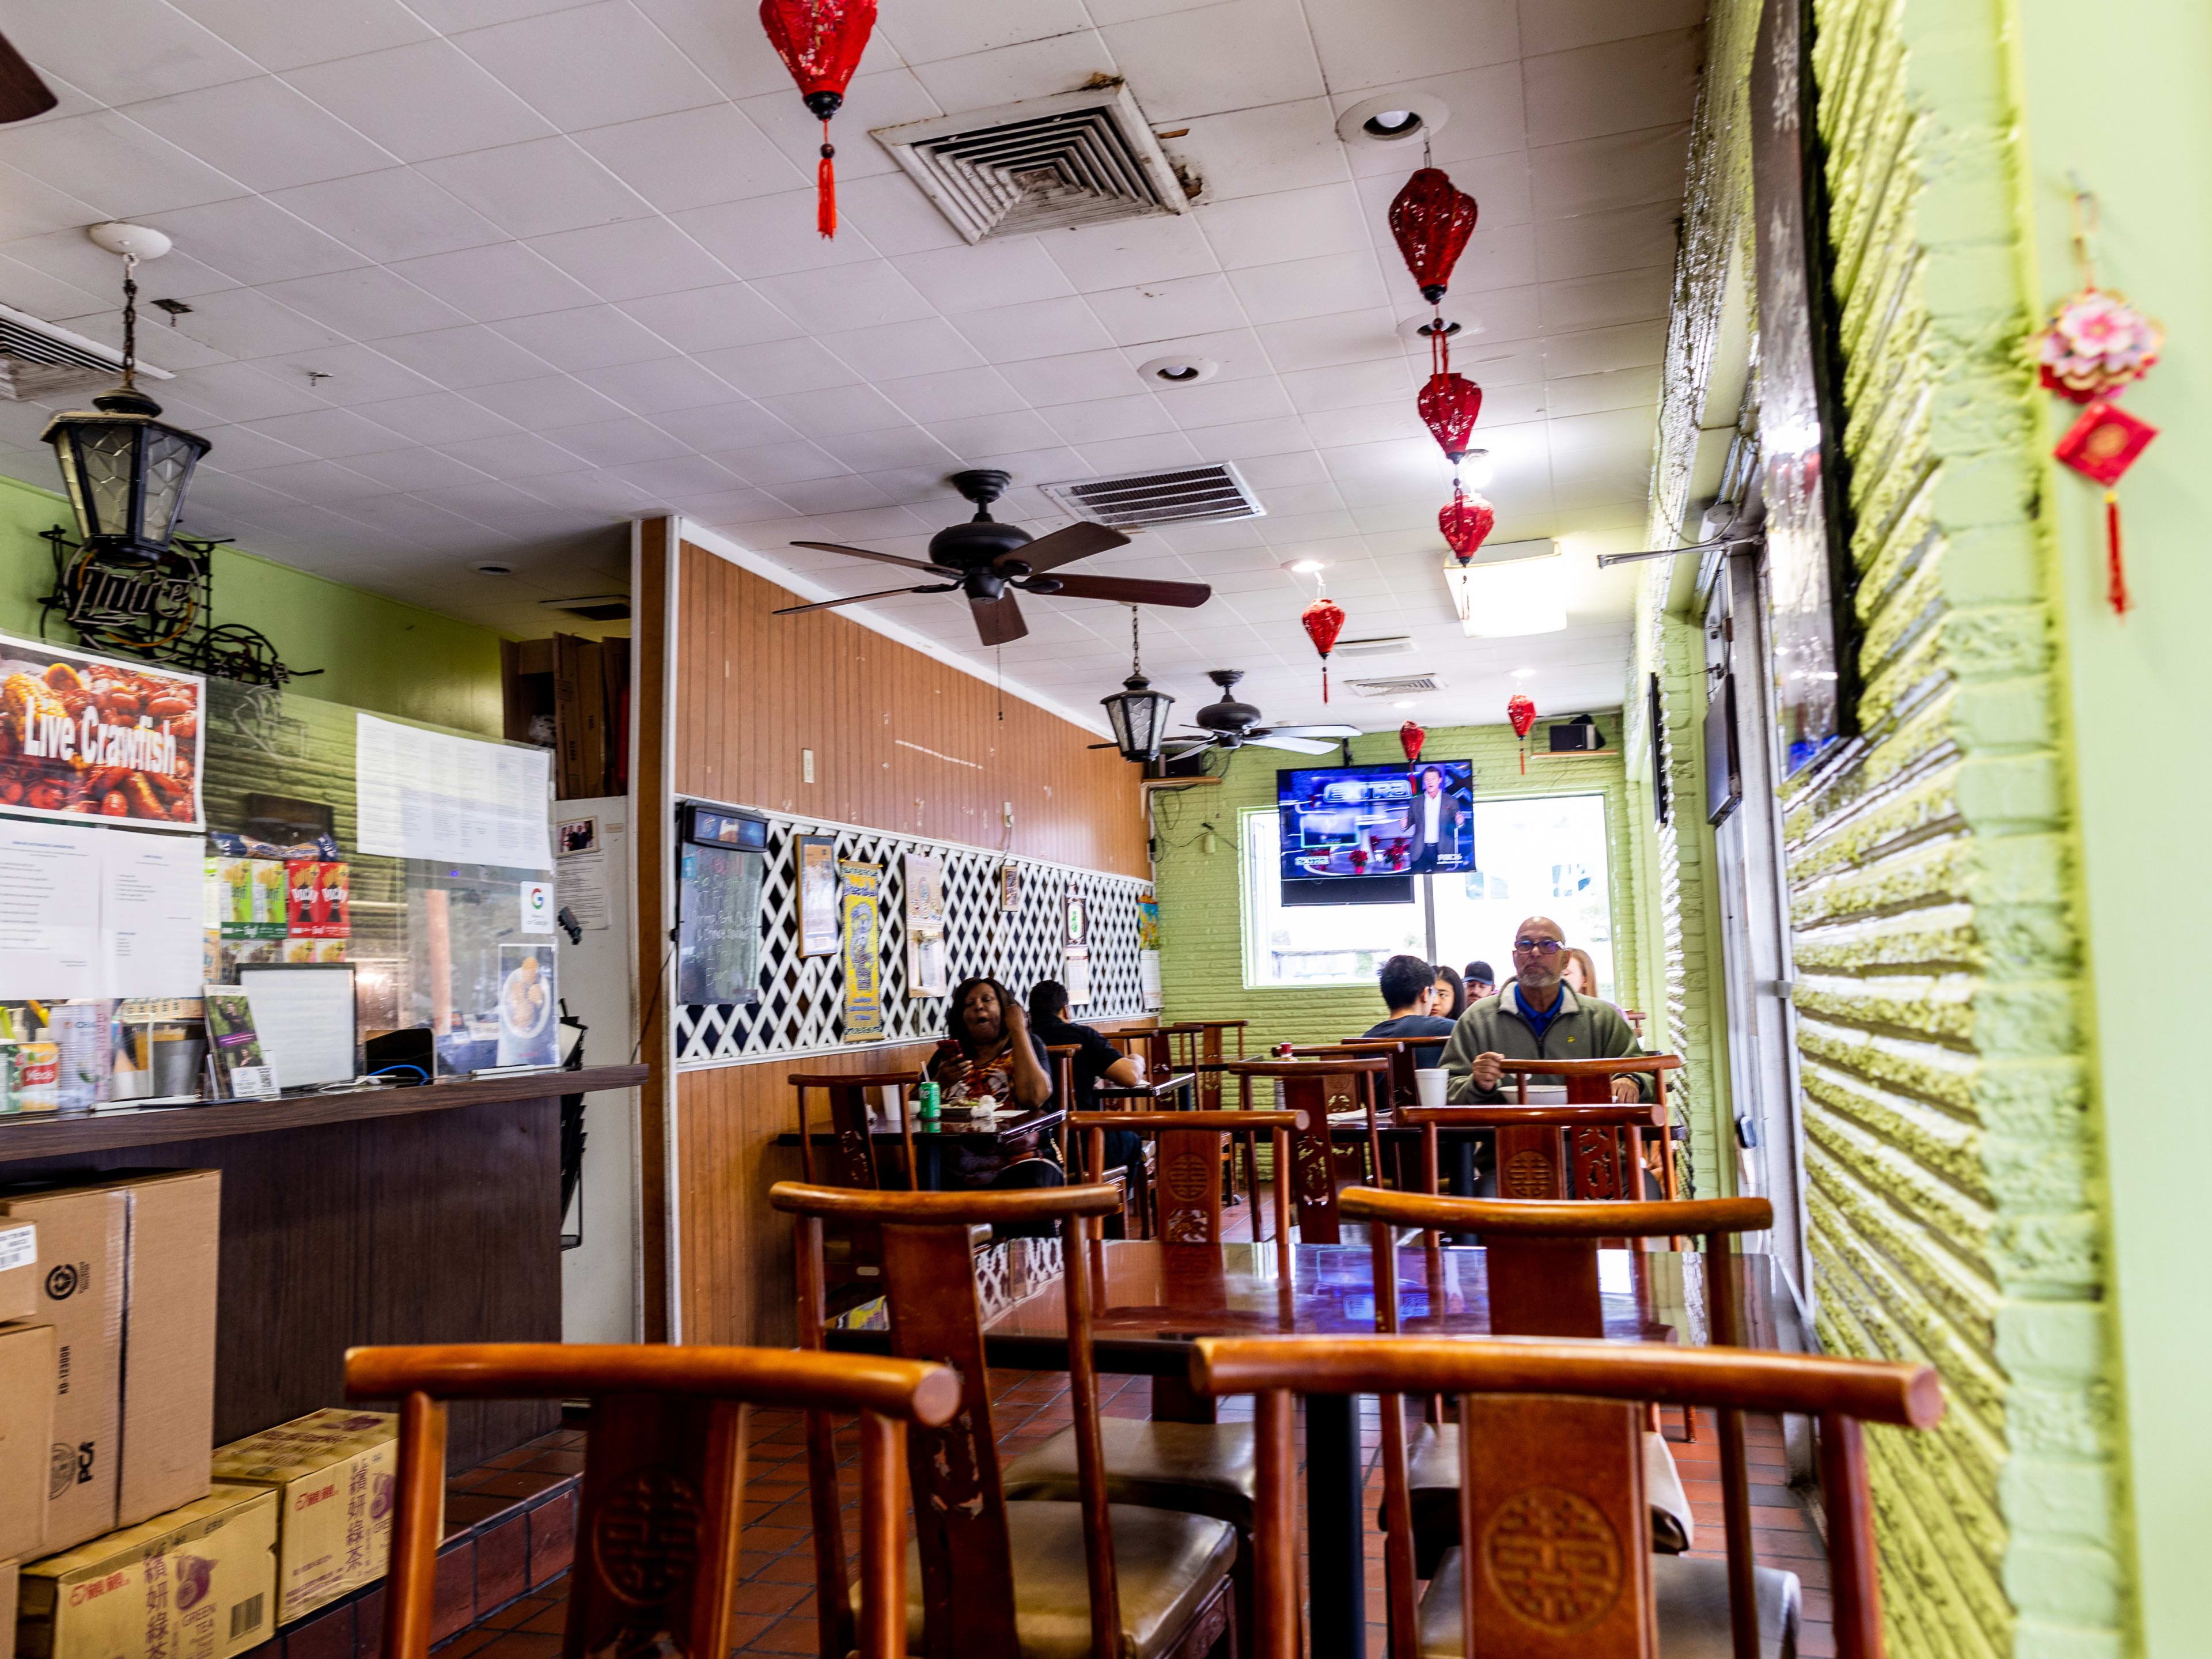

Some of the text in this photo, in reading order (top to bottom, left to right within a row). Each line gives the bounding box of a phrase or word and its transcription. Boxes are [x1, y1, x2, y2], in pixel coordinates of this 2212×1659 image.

[24, 696, 176, 774] Live Crawfish
[77, 1441, 96, 1485] PCA
[181, 1602, 217, 1627] GREEN
[195, 1618, 215, 1634] TEA
